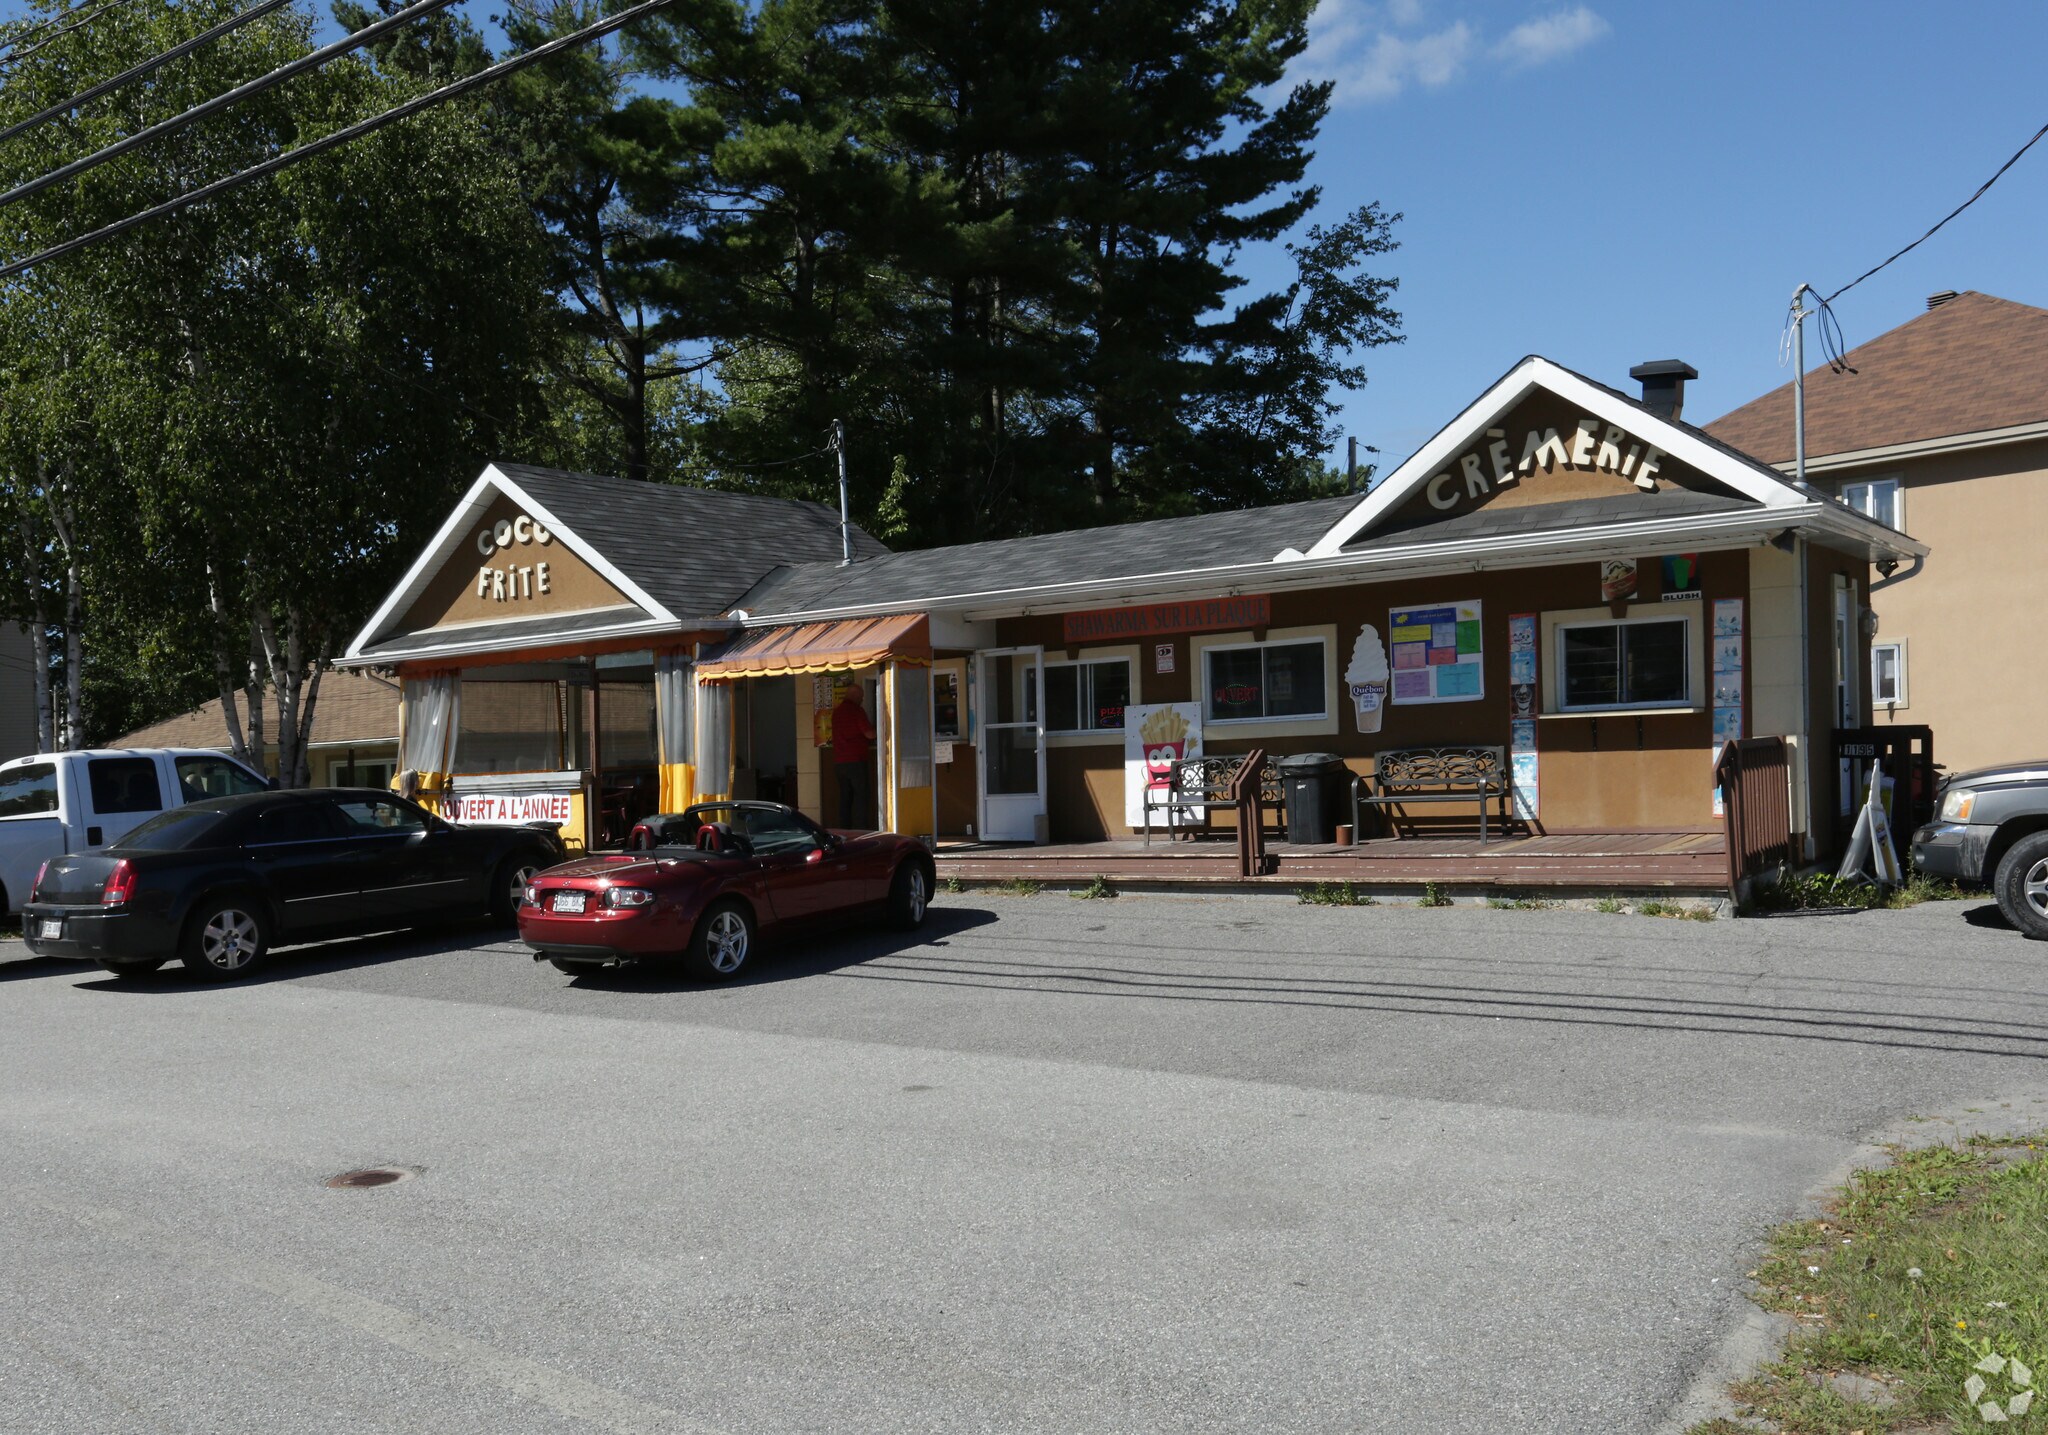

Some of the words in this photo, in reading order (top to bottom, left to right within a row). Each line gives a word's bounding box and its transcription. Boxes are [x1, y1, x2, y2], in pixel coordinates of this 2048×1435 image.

[477, 514, 551, 556] COCO
[1663, 592, 1700, 601] SLUSH
[1067, 608, 1149, 638] SHAWARMA
[1153, 606, 1181, 629] SUR
[1184, 605, 1204, 626] LA
[1206, 598, 1266, 625] PLAQUE
[1352, 684, 1384, 695] Québon
[1845, 744, 1875, 755] 1195
[444, 799, 494, 820] OUVERT
